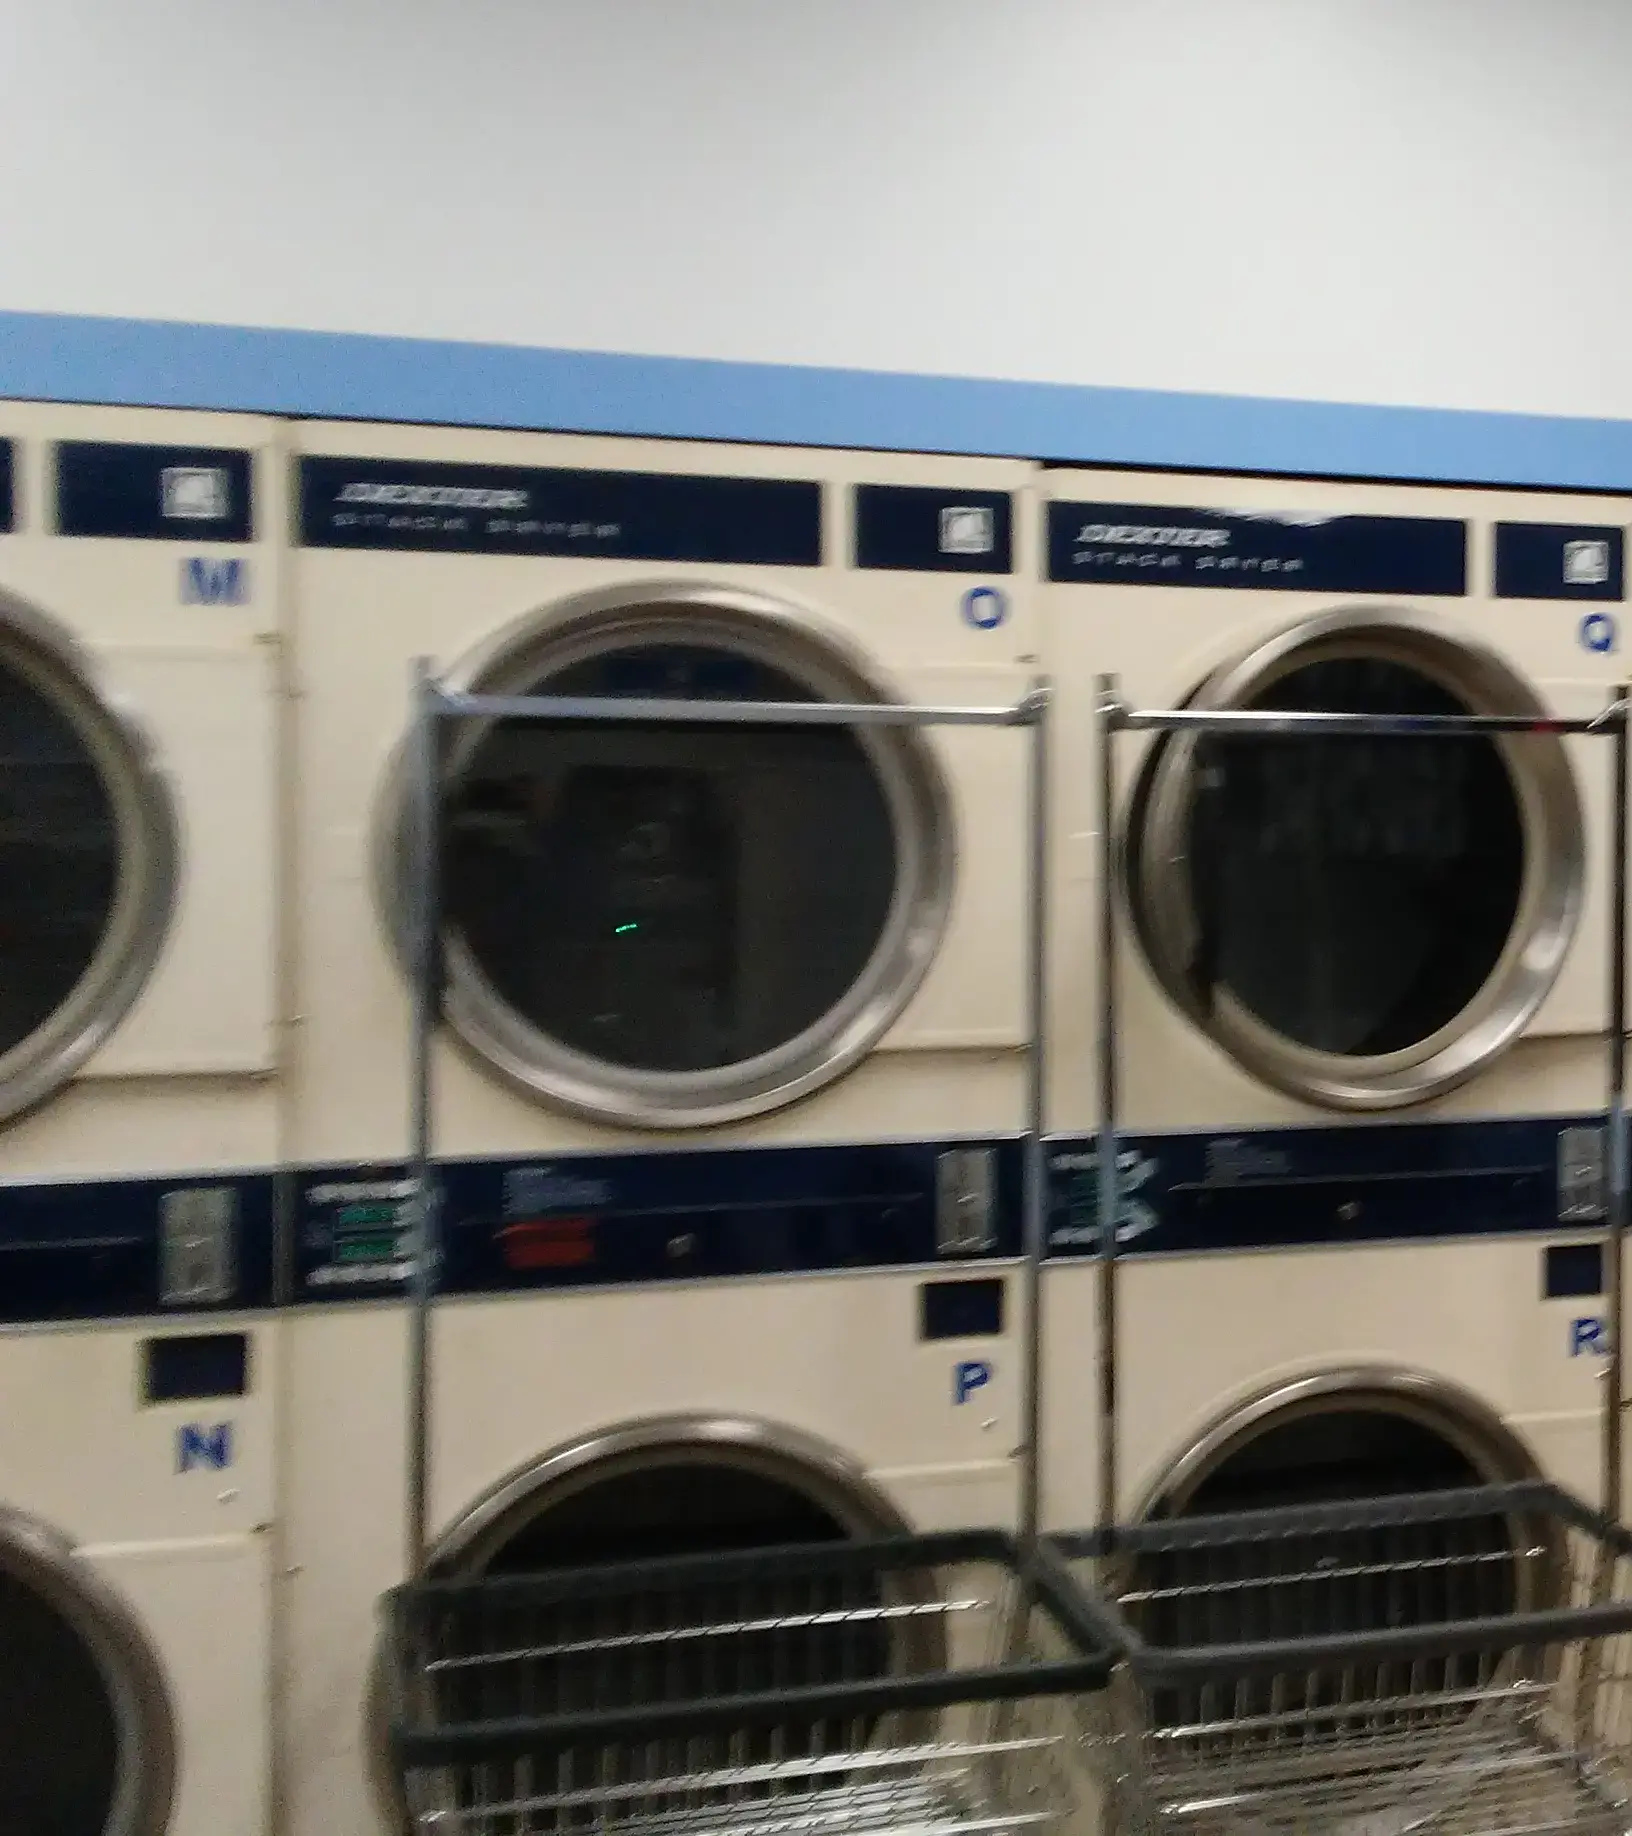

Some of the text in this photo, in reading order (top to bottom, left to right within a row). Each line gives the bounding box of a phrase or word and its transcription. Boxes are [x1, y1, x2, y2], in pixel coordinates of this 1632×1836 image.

[1570, 1317, 1611, 1358] R
[953, 1360, 994, 1404] P
[174, 1422, 234, 1474] N
